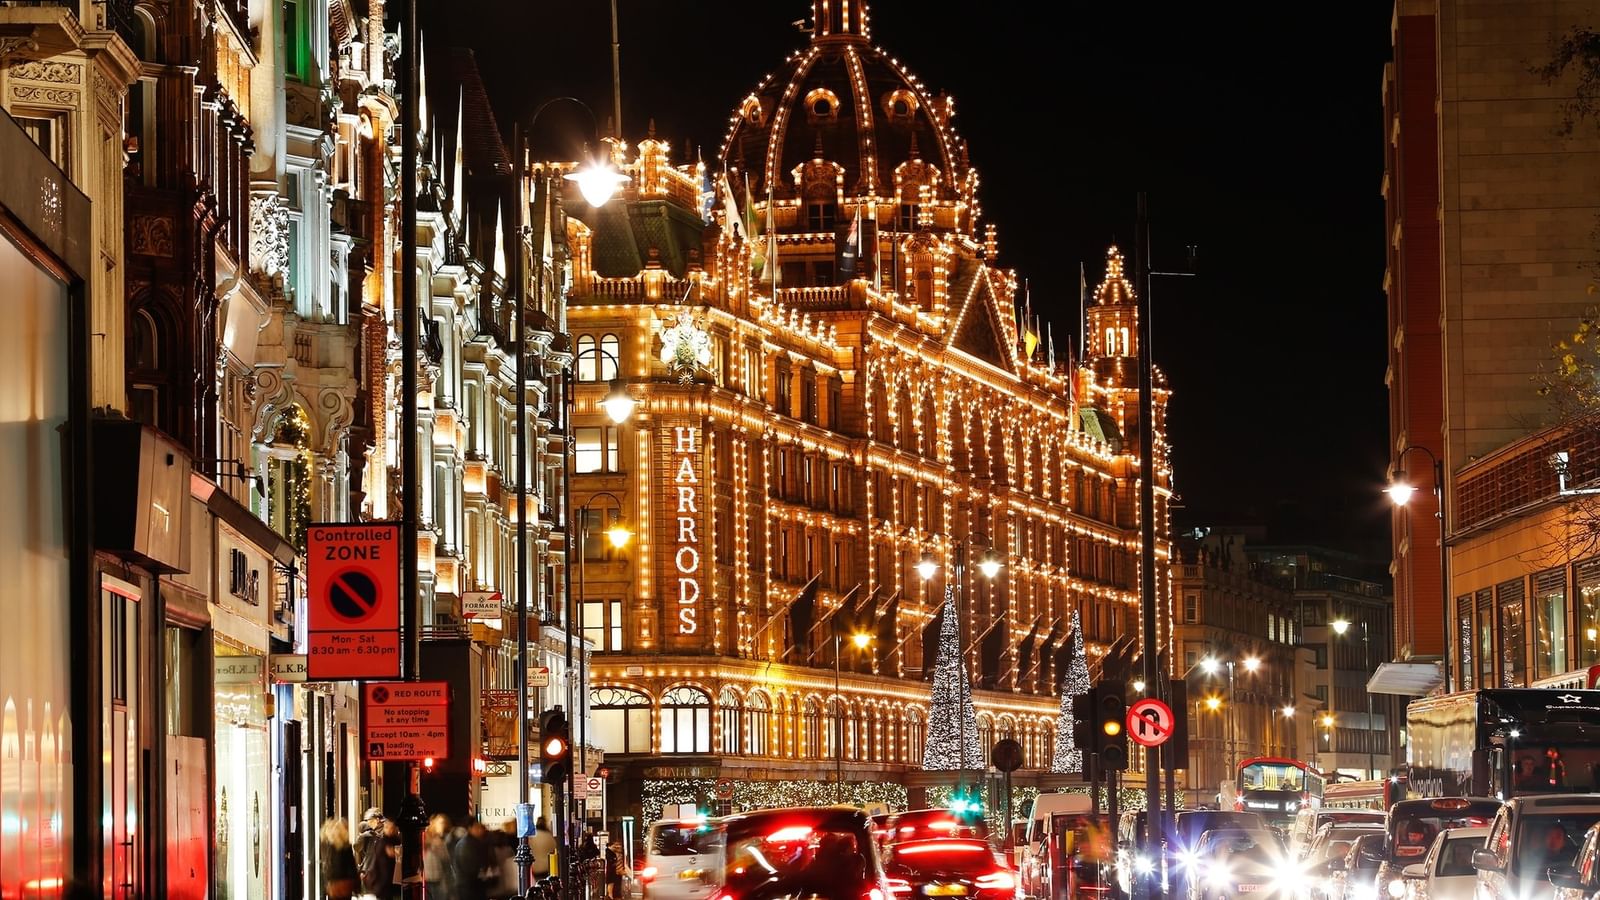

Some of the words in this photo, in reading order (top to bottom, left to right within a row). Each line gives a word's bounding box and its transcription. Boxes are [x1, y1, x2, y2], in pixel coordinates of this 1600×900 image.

[314, 529, 392, 541] Controlled
[674, 426, 700, 635] HARRODS
[325, 545, 380, 560] ZONE
[359, 634, 376, 643] Sat
[312, 646, 335, 655] 8.30
[357, 646, 380, 654] 6.30
[381, 647, 396, 655] pm
[384, 708, 395, 716] No
[397, 708, 430, 717] stopping
[370, 731, 397, 739] Except
[427, 731, 445, 739] 4pm
